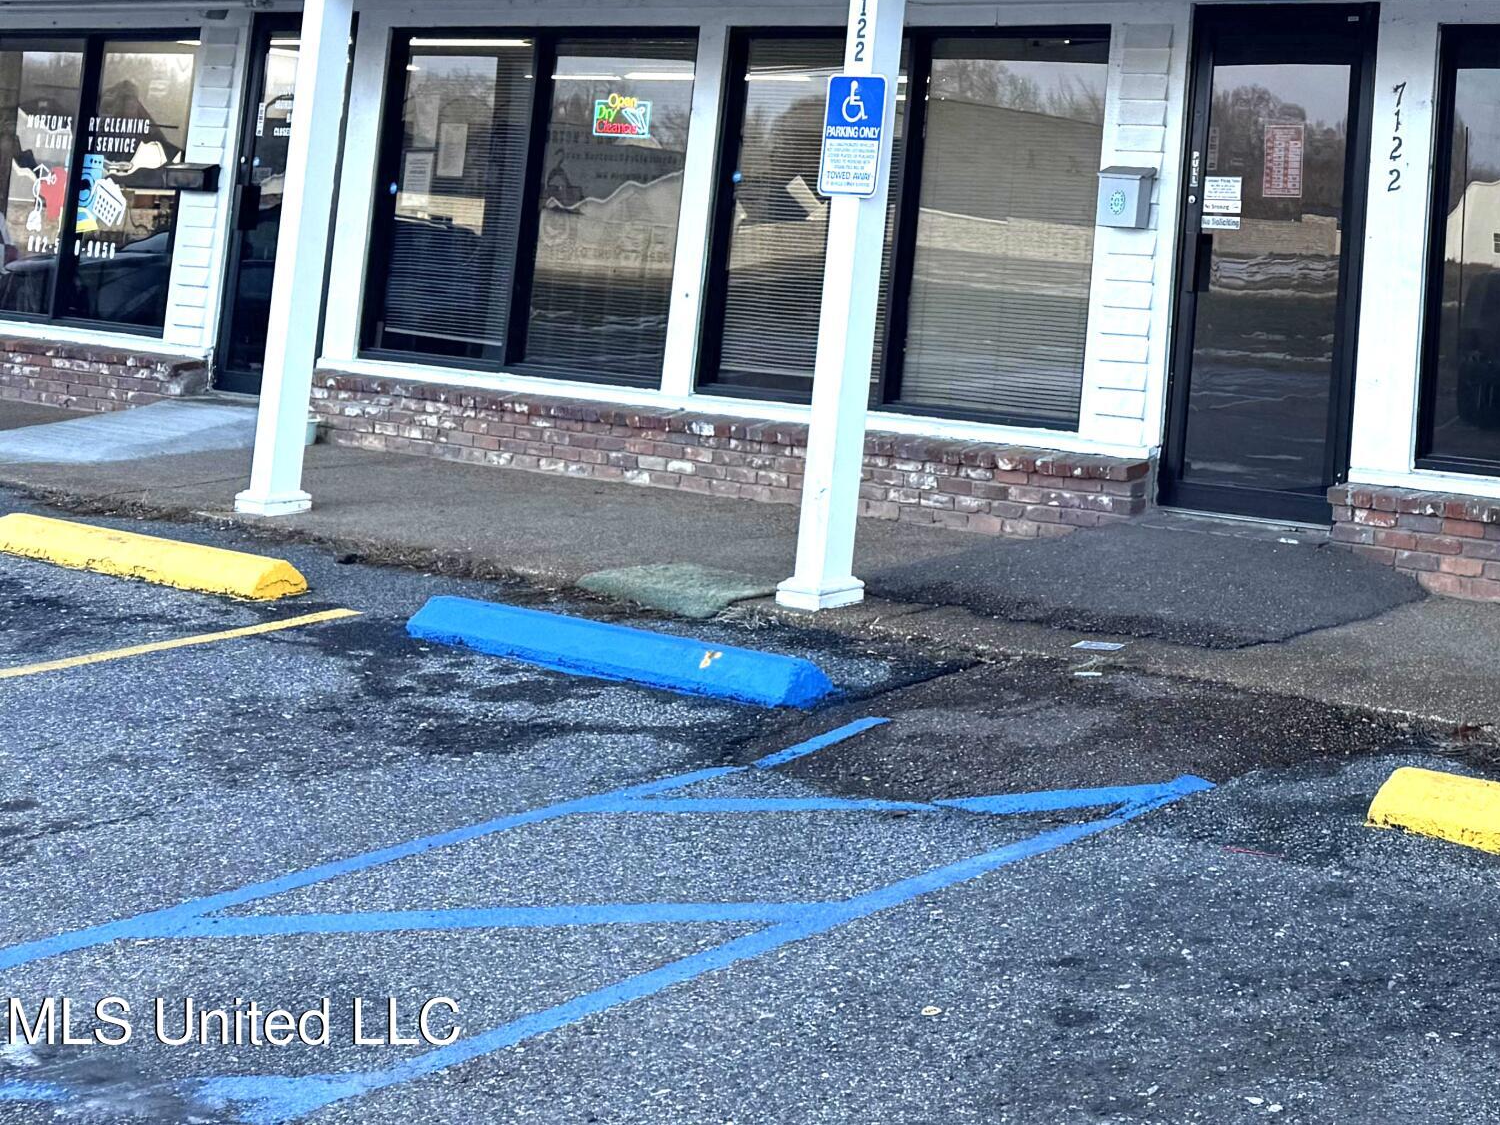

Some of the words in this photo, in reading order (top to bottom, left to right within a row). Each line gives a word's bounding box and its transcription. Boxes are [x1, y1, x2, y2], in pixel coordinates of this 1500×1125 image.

[608, 93, 638, 109] Open
[596, 104, 617, 123] Dry
[104, 118, 151, 134] CLEANING
[826, 125, 859, 138] PARKING
[860, 126, 880, 139] ONLY
[1387, 81, 1407, 192] 7122
[96, 137, 137, 153] SERVICE
[826, 171, 851, 180] TOWED
